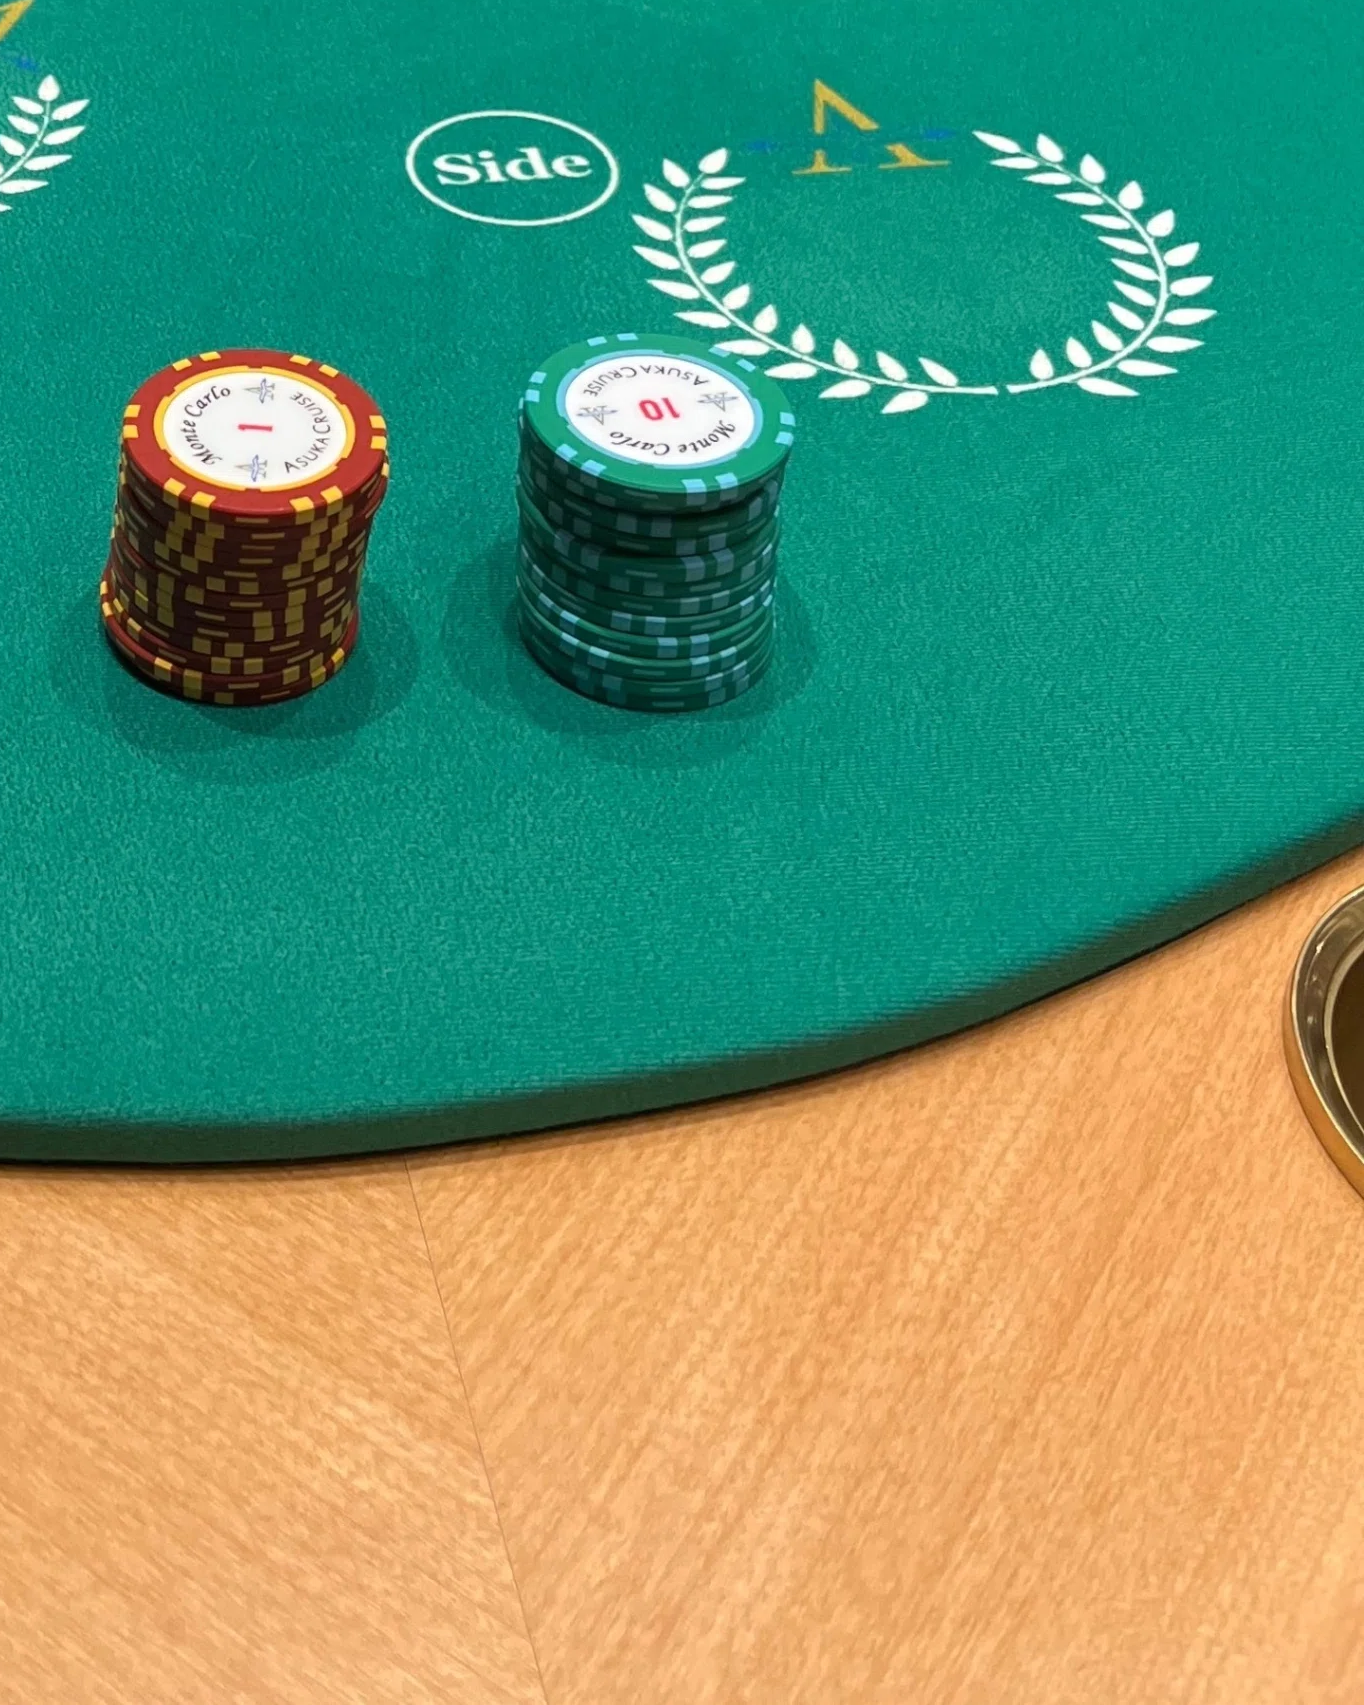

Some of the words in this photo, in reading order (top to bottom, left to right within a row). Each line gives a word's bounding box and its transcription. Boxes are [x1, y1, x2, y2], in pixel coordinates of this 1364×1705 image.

[433, 146, 593, 186] Side
[184, 385, 231, 418] Carlo
[638, 397, 681, 421] 10
[180, 419, 223, 465] Monte
[237, 423, 273, 433] 1
[609, 431, 670, 456] Carlo
[678, 420, 736, 454] Monte
